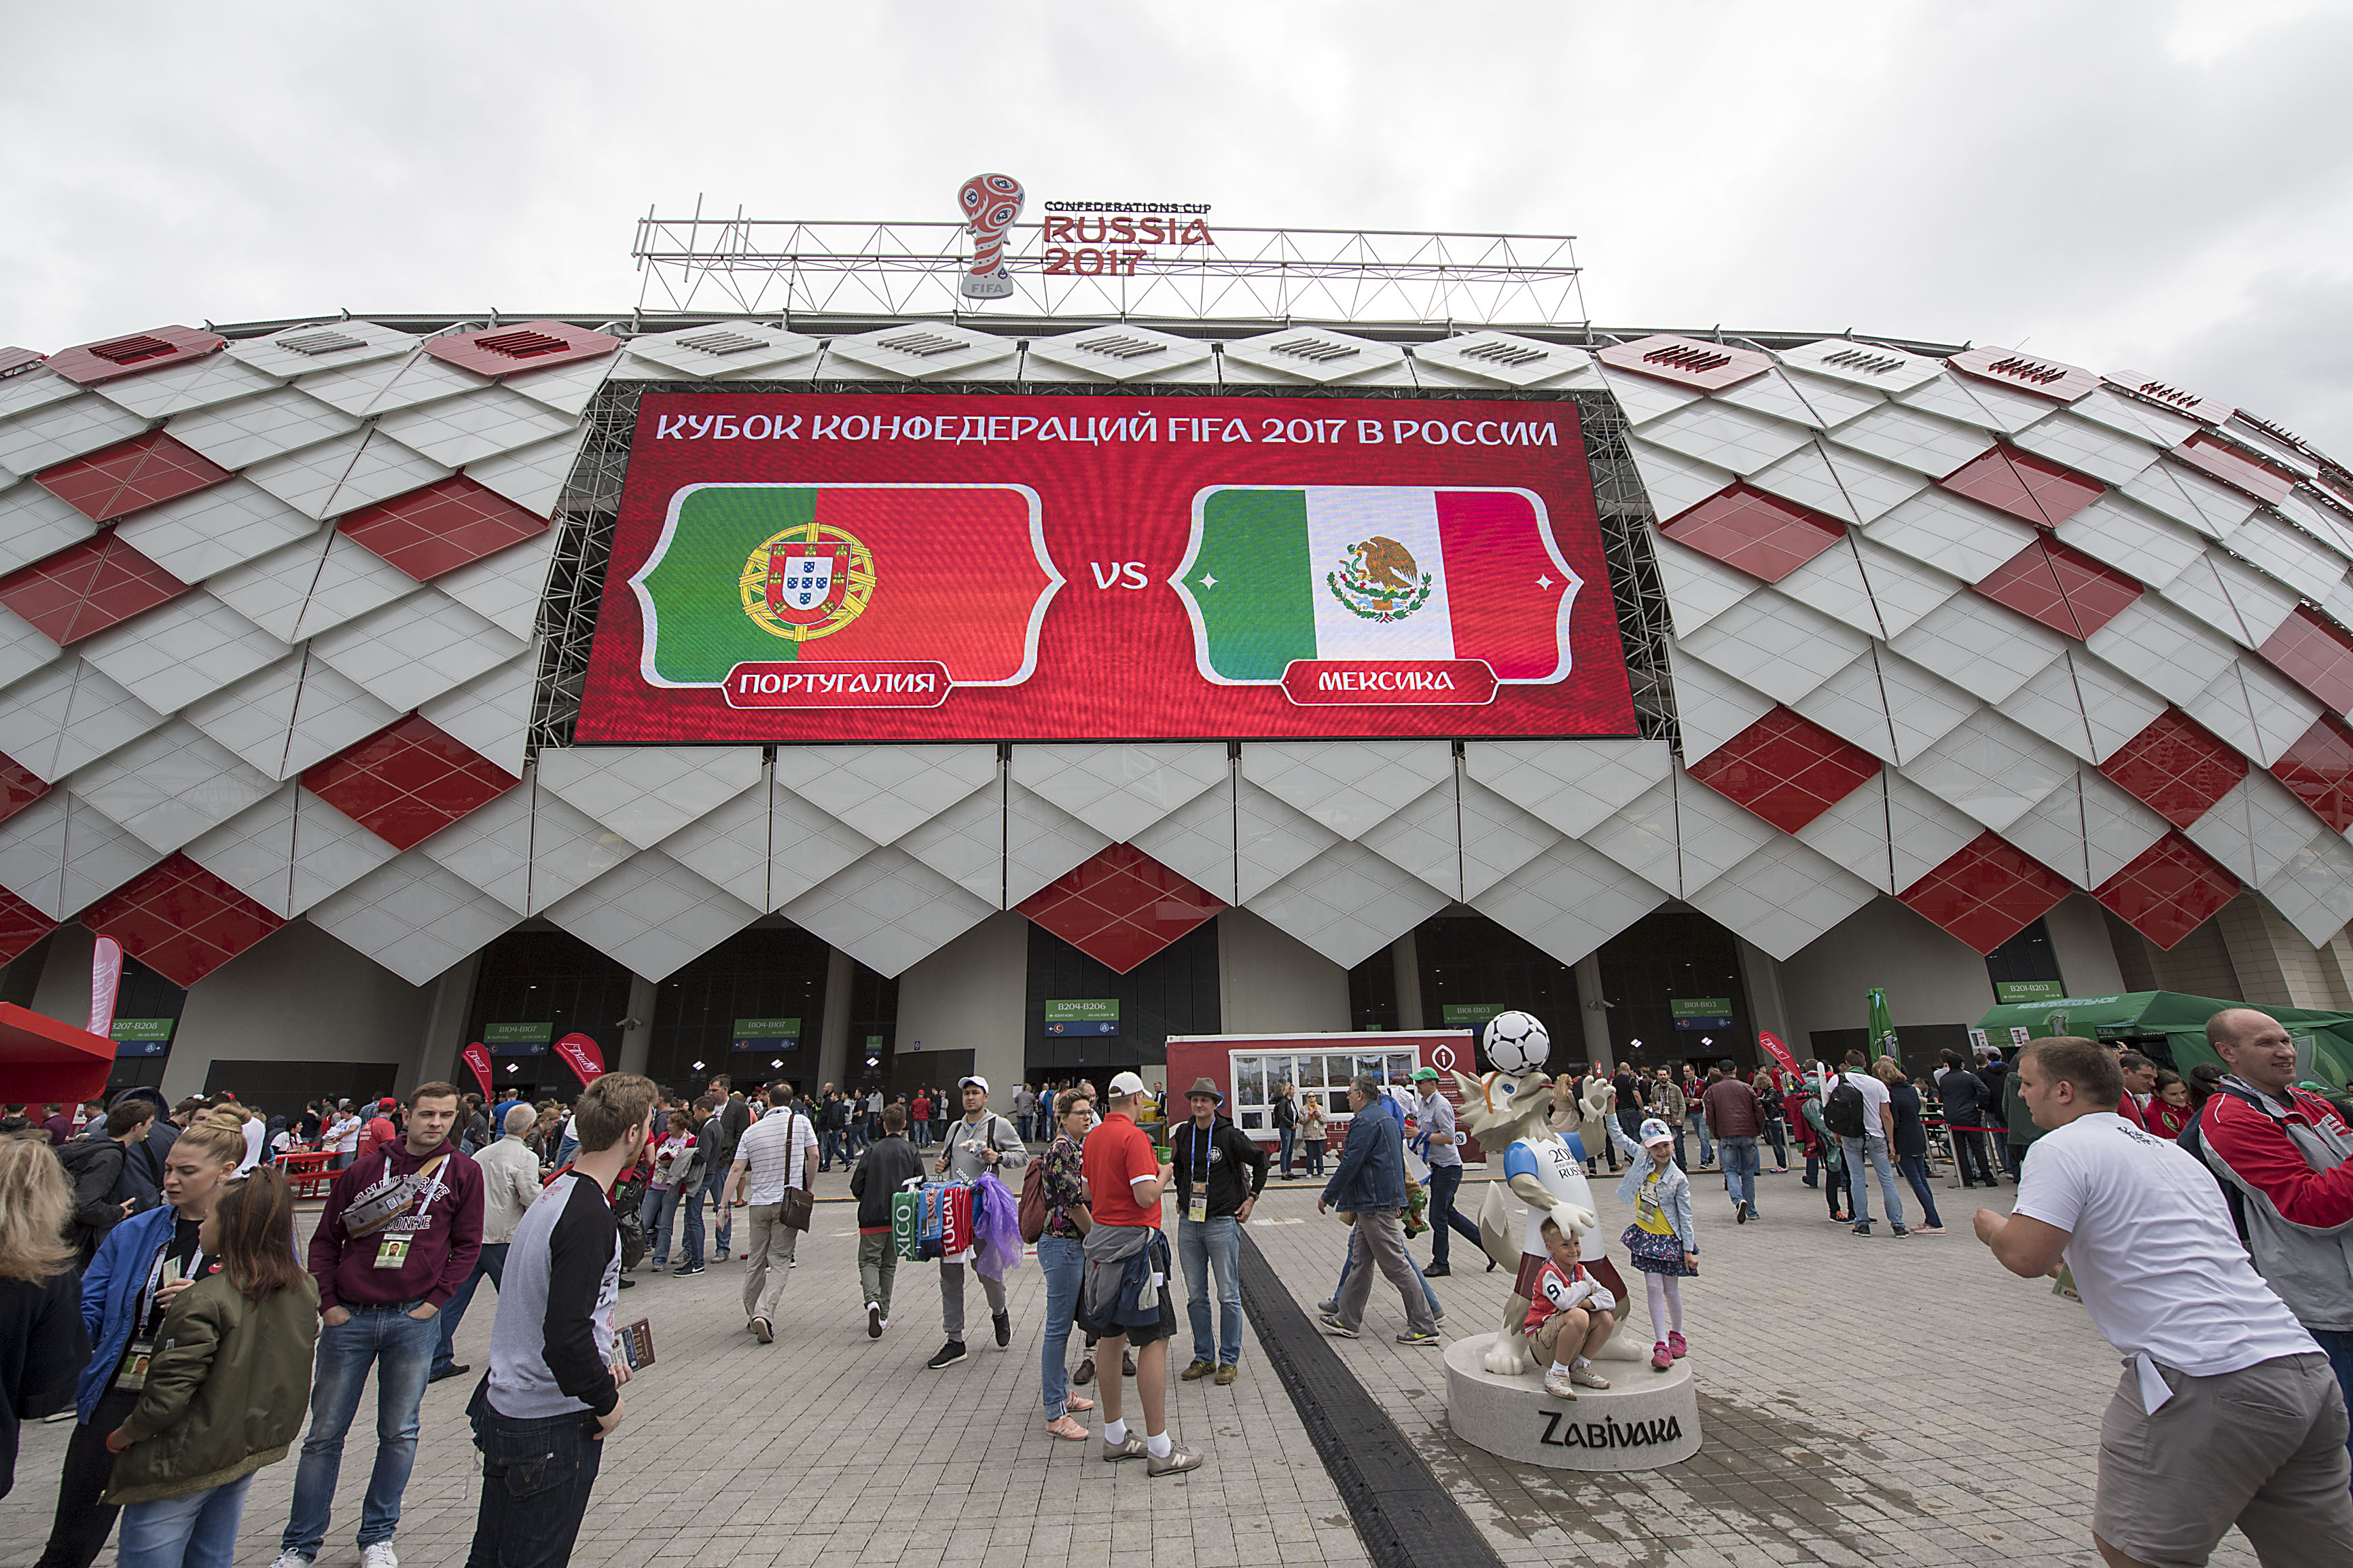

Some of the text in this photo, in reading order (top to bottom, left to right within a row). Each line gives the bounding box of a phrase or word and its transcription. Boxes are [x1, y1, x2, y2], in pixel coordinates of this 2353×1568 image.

[1045, 201, 1212, 214] CONFEDERATIONS CUP
[1044, 215, 1215, 245] RUSSIA
[1043, 248, 1147, 276] 2017
[971, 284, 1005, 294] FIFA
[655, 414, 802, 440] КУБОК
[812, 409, 1157, 445] КОНФЕДЕРАЦИЙ
[1168, 418, 1253, 443] FIFA
[1261, 418, 1347, 444] 2017
[1395, 420, 1558, 446] РОССИИ
[1092, 562, 1149, 590] VS
[738, 671, 937, 696] ПОРТУГАЛИЯ
[1318, 670, 1456, 693] МЕКСИКА
[2017, 996, 2119, 1009] БЕЗАЛКОГОЛЬНОЕ
[147, 1272, 159, 1300] МОСКВА
[1547, 1283, 1561, 1301] 9
[1125, 1440, 1141, 1453] N
[1171, 1453, 1186, 1467] N
